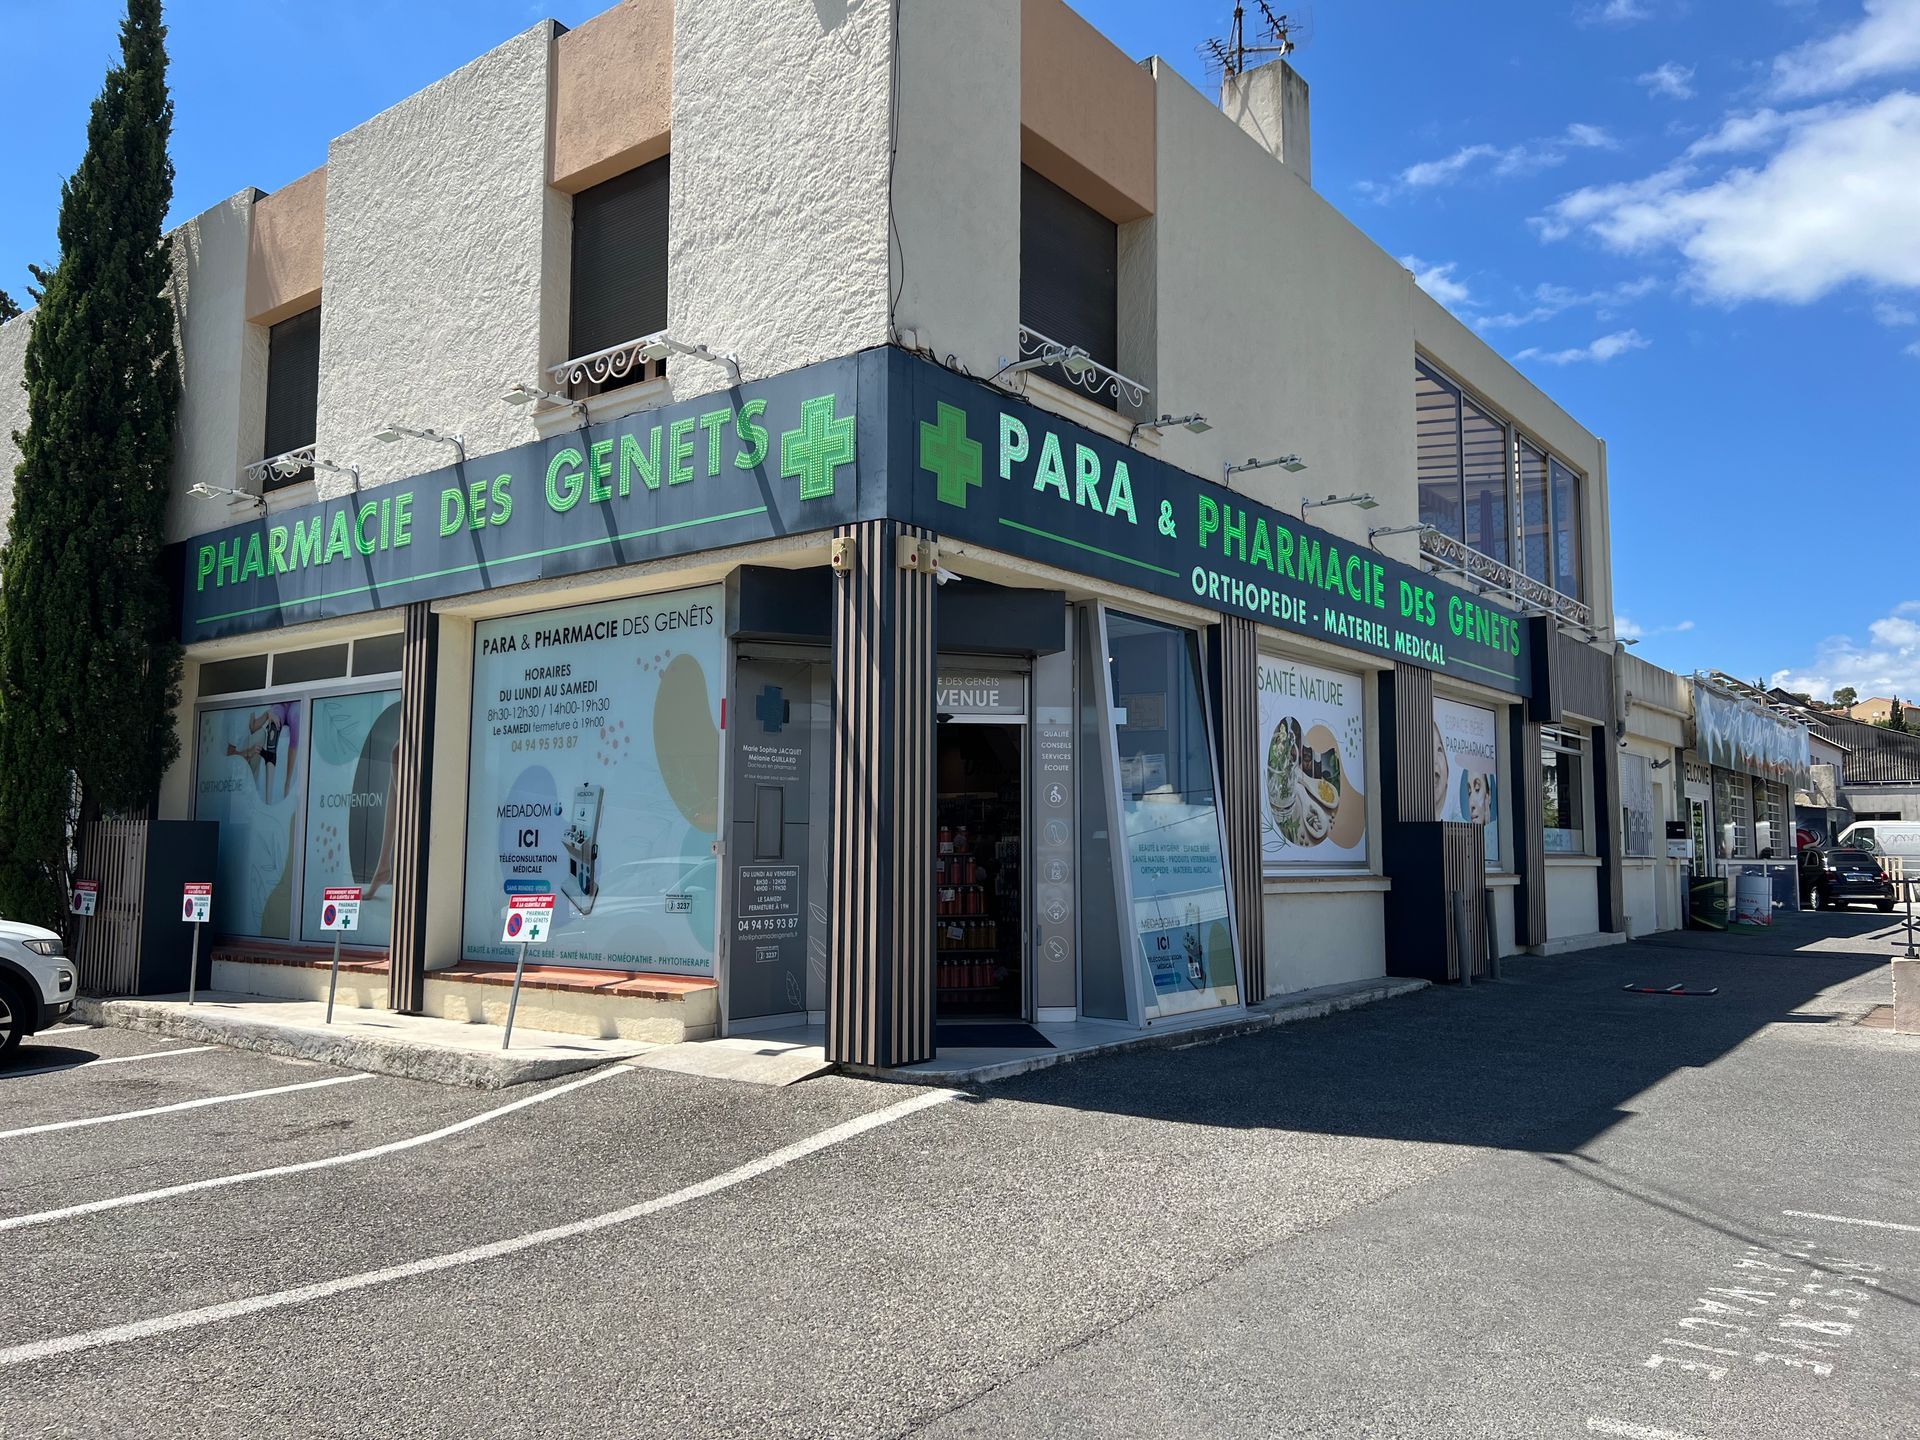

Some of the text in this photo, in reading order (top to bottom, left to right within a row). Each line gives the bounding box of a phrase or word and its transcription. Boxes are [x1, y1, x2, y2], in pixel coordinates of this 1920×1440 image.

[197, 399, 769, 591] PHARMACIE DES GENETS
[1000, 412, 1520, 657] PARA & PHARMACIE DES GENETS
[1192, 566, 1306, 625] ORTHOPEDIE
[1324, 607, 1390, 649] MATERIEL
[1394, 630, 1446, 666] MEDICAL
[483, 604, 714, 655] PARA & PHARMACIE DES GENÊTS
[525, 664, 571, 681] HORAIRES
[946, 677, 962, 686] DES
[965, 676, 999, 687] GENÊTS
[1257, 665, 1343, 706] SANTÉ NATURE
[499, 680, 598, 702] DU LUNDI AU SAMEDI
[937, 689, 999, 707] VENUE
[488, 704, 539, 721] 8h30-12h30
[549, 697, 610, 716] 14h00-19h30
[493, 716, 605, 736] Le SAMEDI fermeture à 19h00
[1043, 730, 1069, 738] QUALITÉ
[511, 736, 578, 752] 04 94 95 93 87
[327, 793, 383, 808] CONTENTION
[497, 803, 551, 818] MEDADOM
[518, 829, 539, 848] ICI
[513, 864, 542, 873] MÉDICALE
[676, 902, 690, 910] 3237
[738, 918, 798, 931] 04 94 95 93 87
[1157, 936, 1170, 950] ICI
[560, 950, 578, 959] SANTÉ
[580, 951, 602, 961] NATURE
[607, 952, 652, 964] HOMÉOPATHIE
